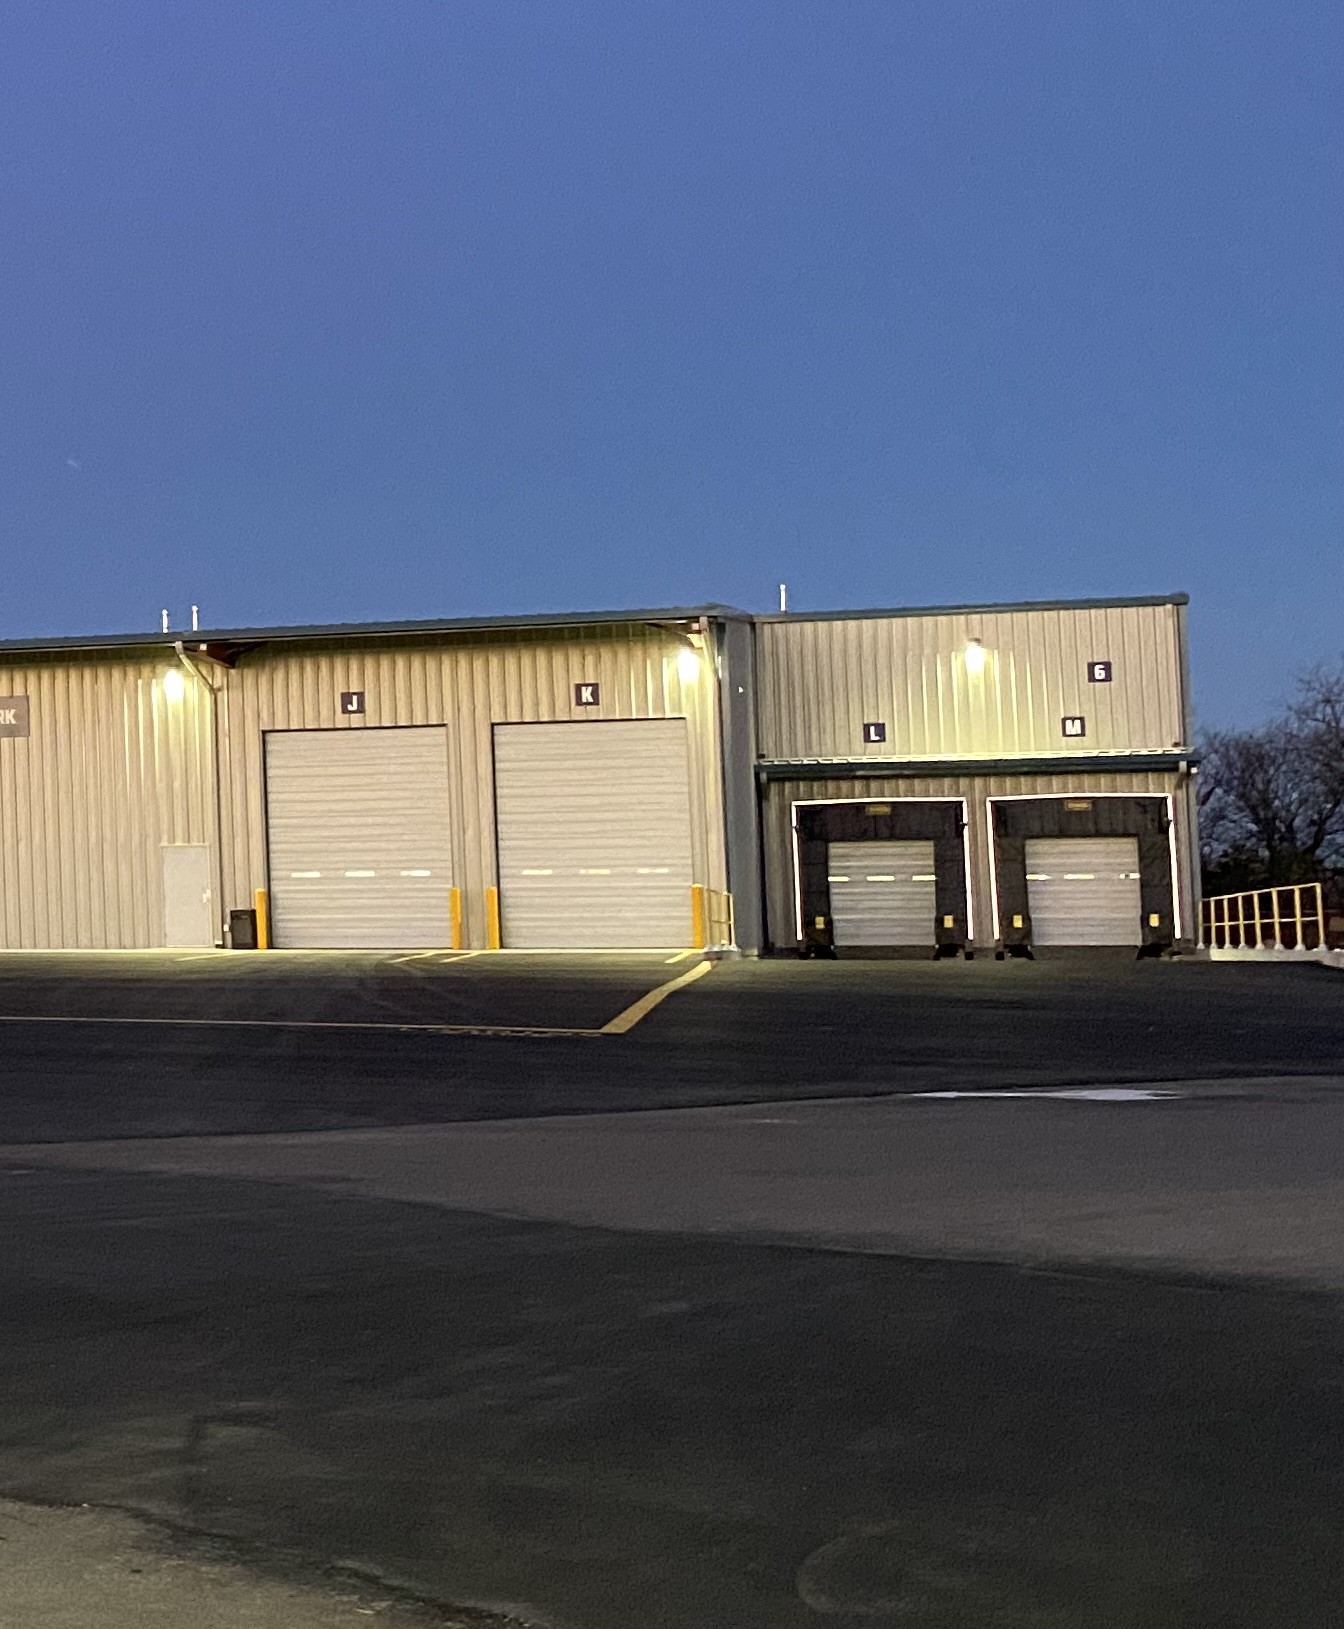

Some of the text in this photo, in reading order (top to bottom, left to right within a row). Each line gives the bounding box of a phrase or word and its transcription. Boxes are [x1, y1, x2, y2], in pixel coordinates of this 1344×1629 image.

[1094, 664, 1106, 680] 6
[581, 686, 594, 703] K
[347, 695, 358, 711] J
[869, 725, 880, 741] L
[1065, 719, 1081, 735] M
